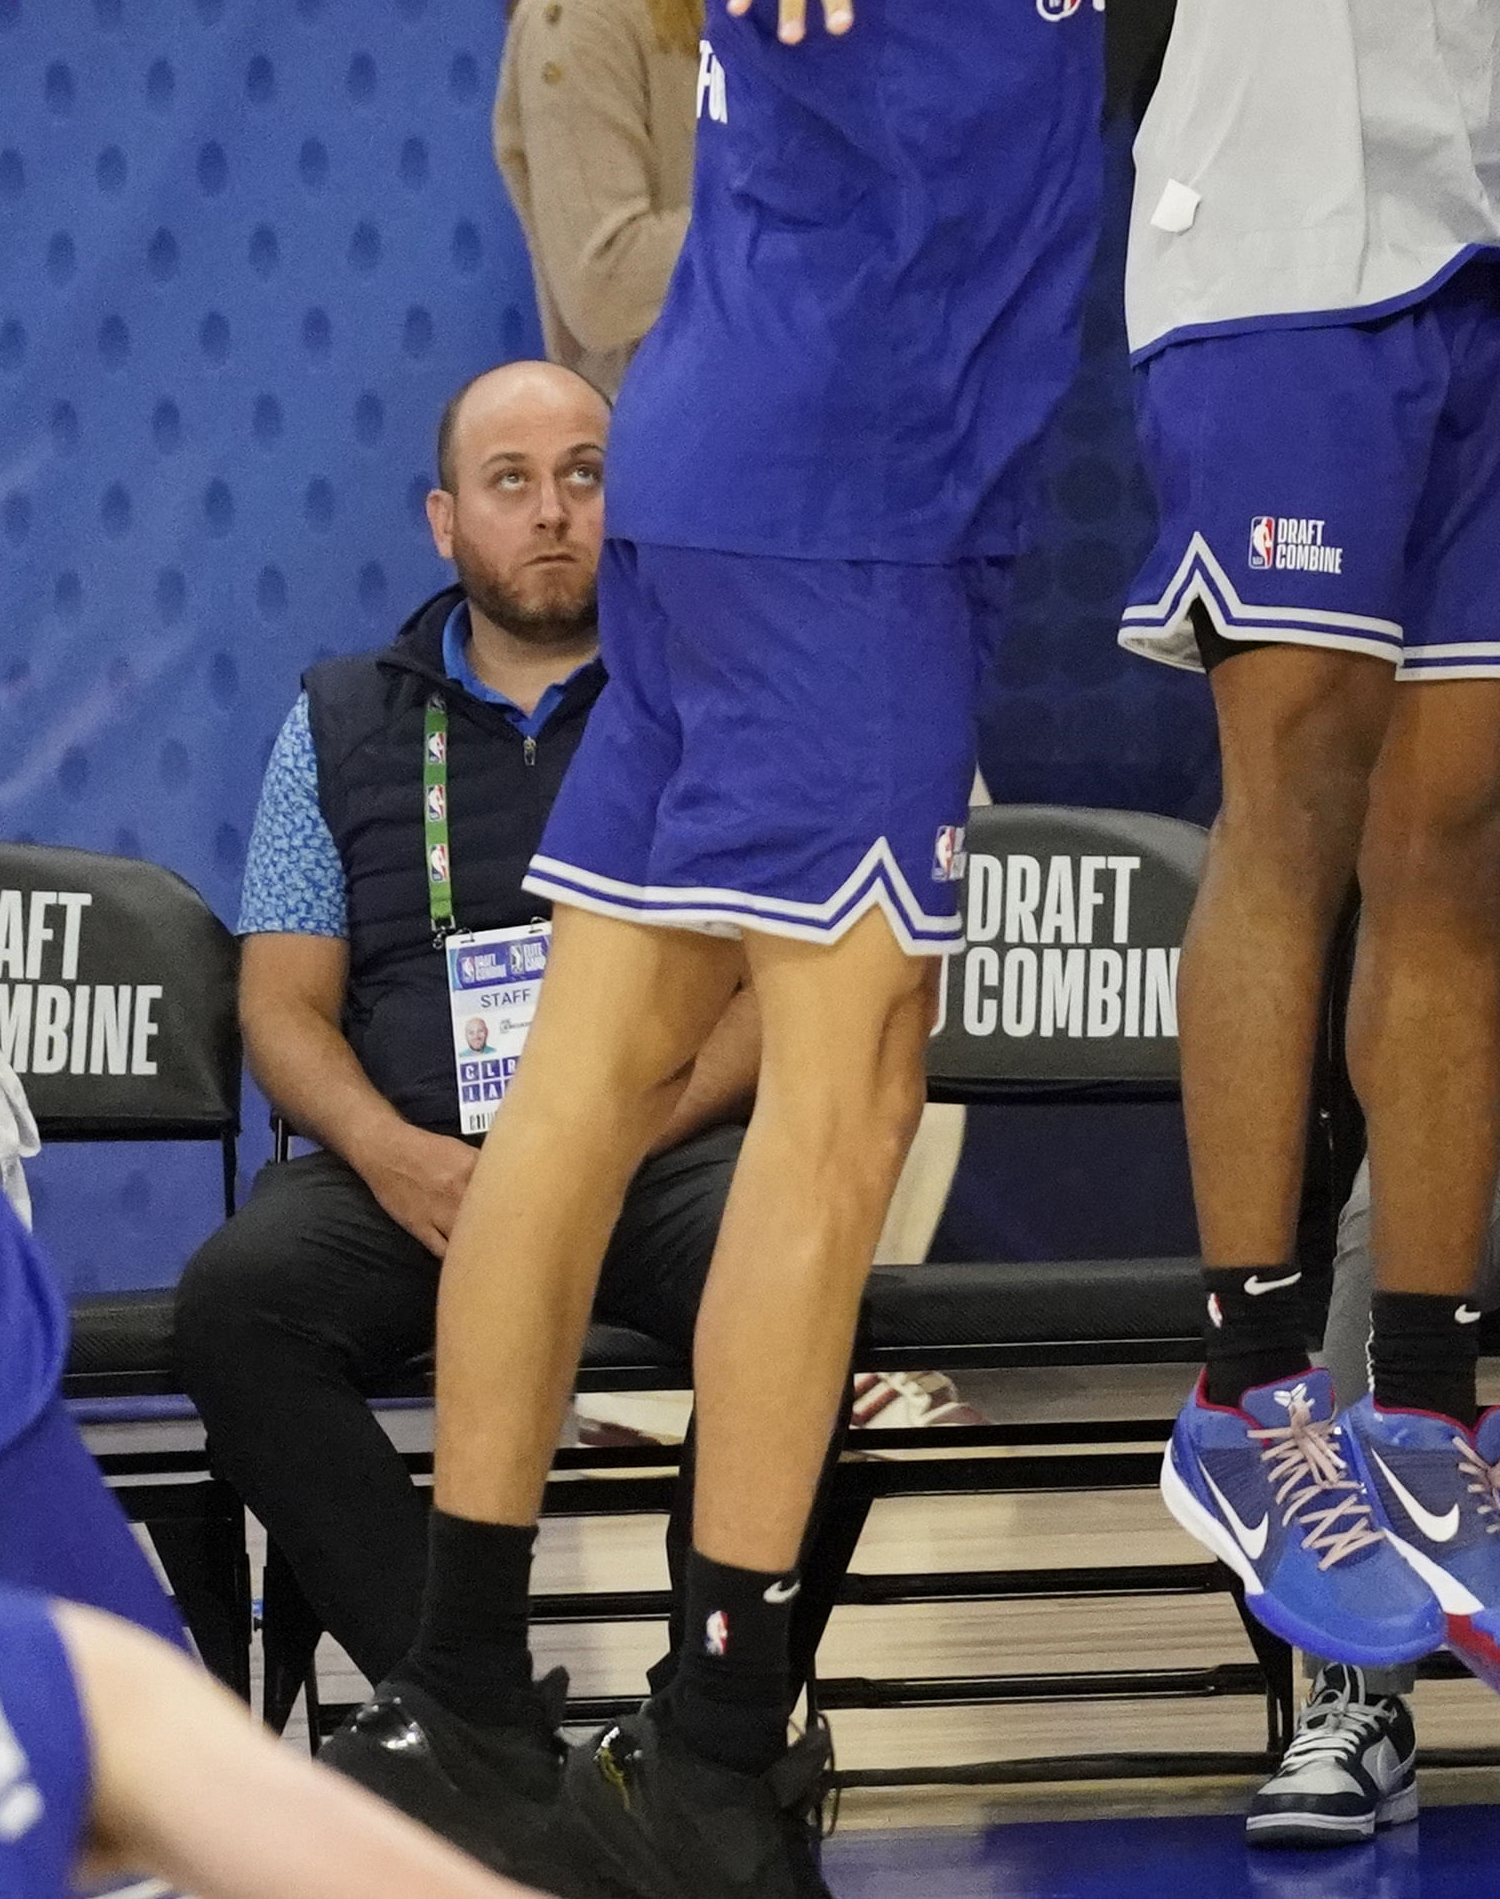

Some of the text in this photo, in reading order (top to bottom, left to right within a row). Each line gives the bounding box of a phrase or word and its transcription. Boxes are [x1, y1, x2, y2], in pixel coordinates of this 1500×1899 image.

[1277, 518, 1325, 546] DRAFT
[1275, 543, 1343, 574] COMBINE
[967, 854, 1141, 943] DRAFT
[481, 988, 531, 1008] STAFF
[963, 946, 1181, 1037] COMBIN
